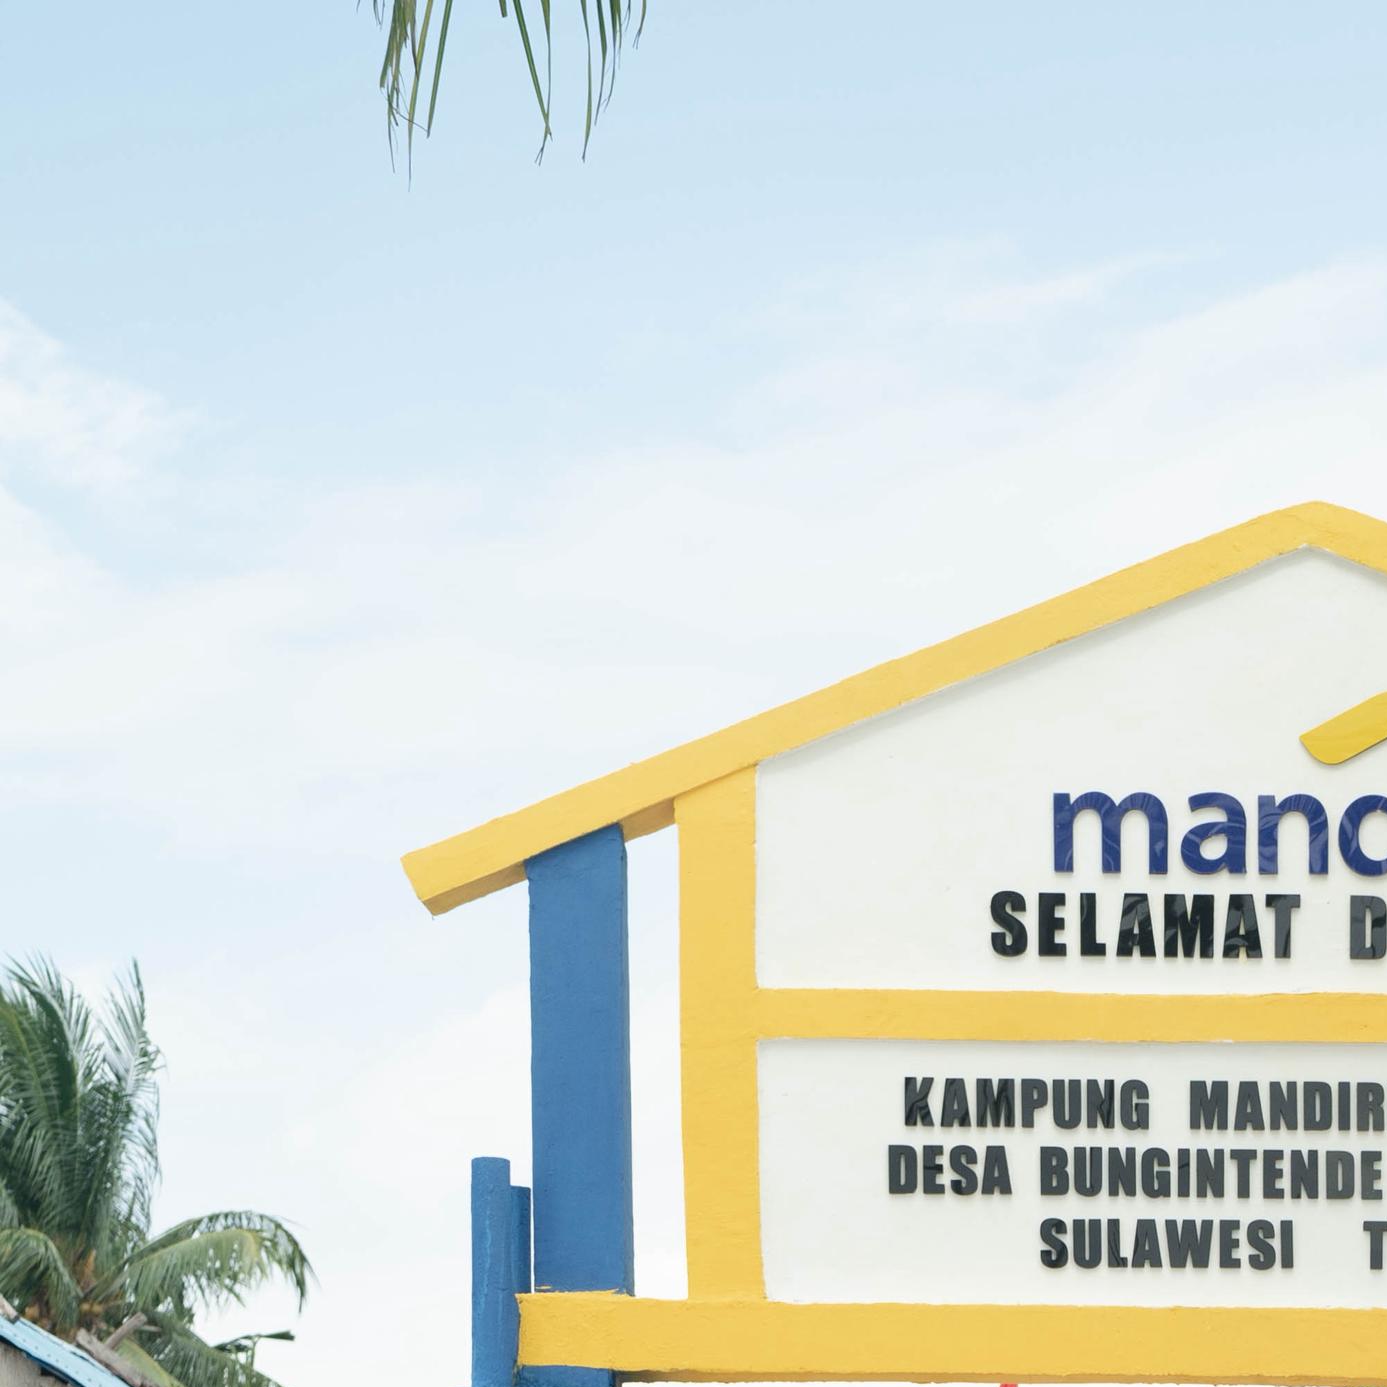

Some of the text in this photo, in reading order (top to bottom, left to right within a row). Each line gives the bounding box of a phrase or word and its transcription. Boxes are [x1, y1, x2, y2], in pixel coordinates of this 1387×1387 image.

[990, 890, 1301, 959] SELAMAT
[904, 1076, 1150, 1131] KAMPUNG
[888, 1144, 1013, 1196] DESA
[1039, 1146, 1383, 1201] BUNGINTENDE
[1039, 1217, 1294, 1271] SULAWESI
